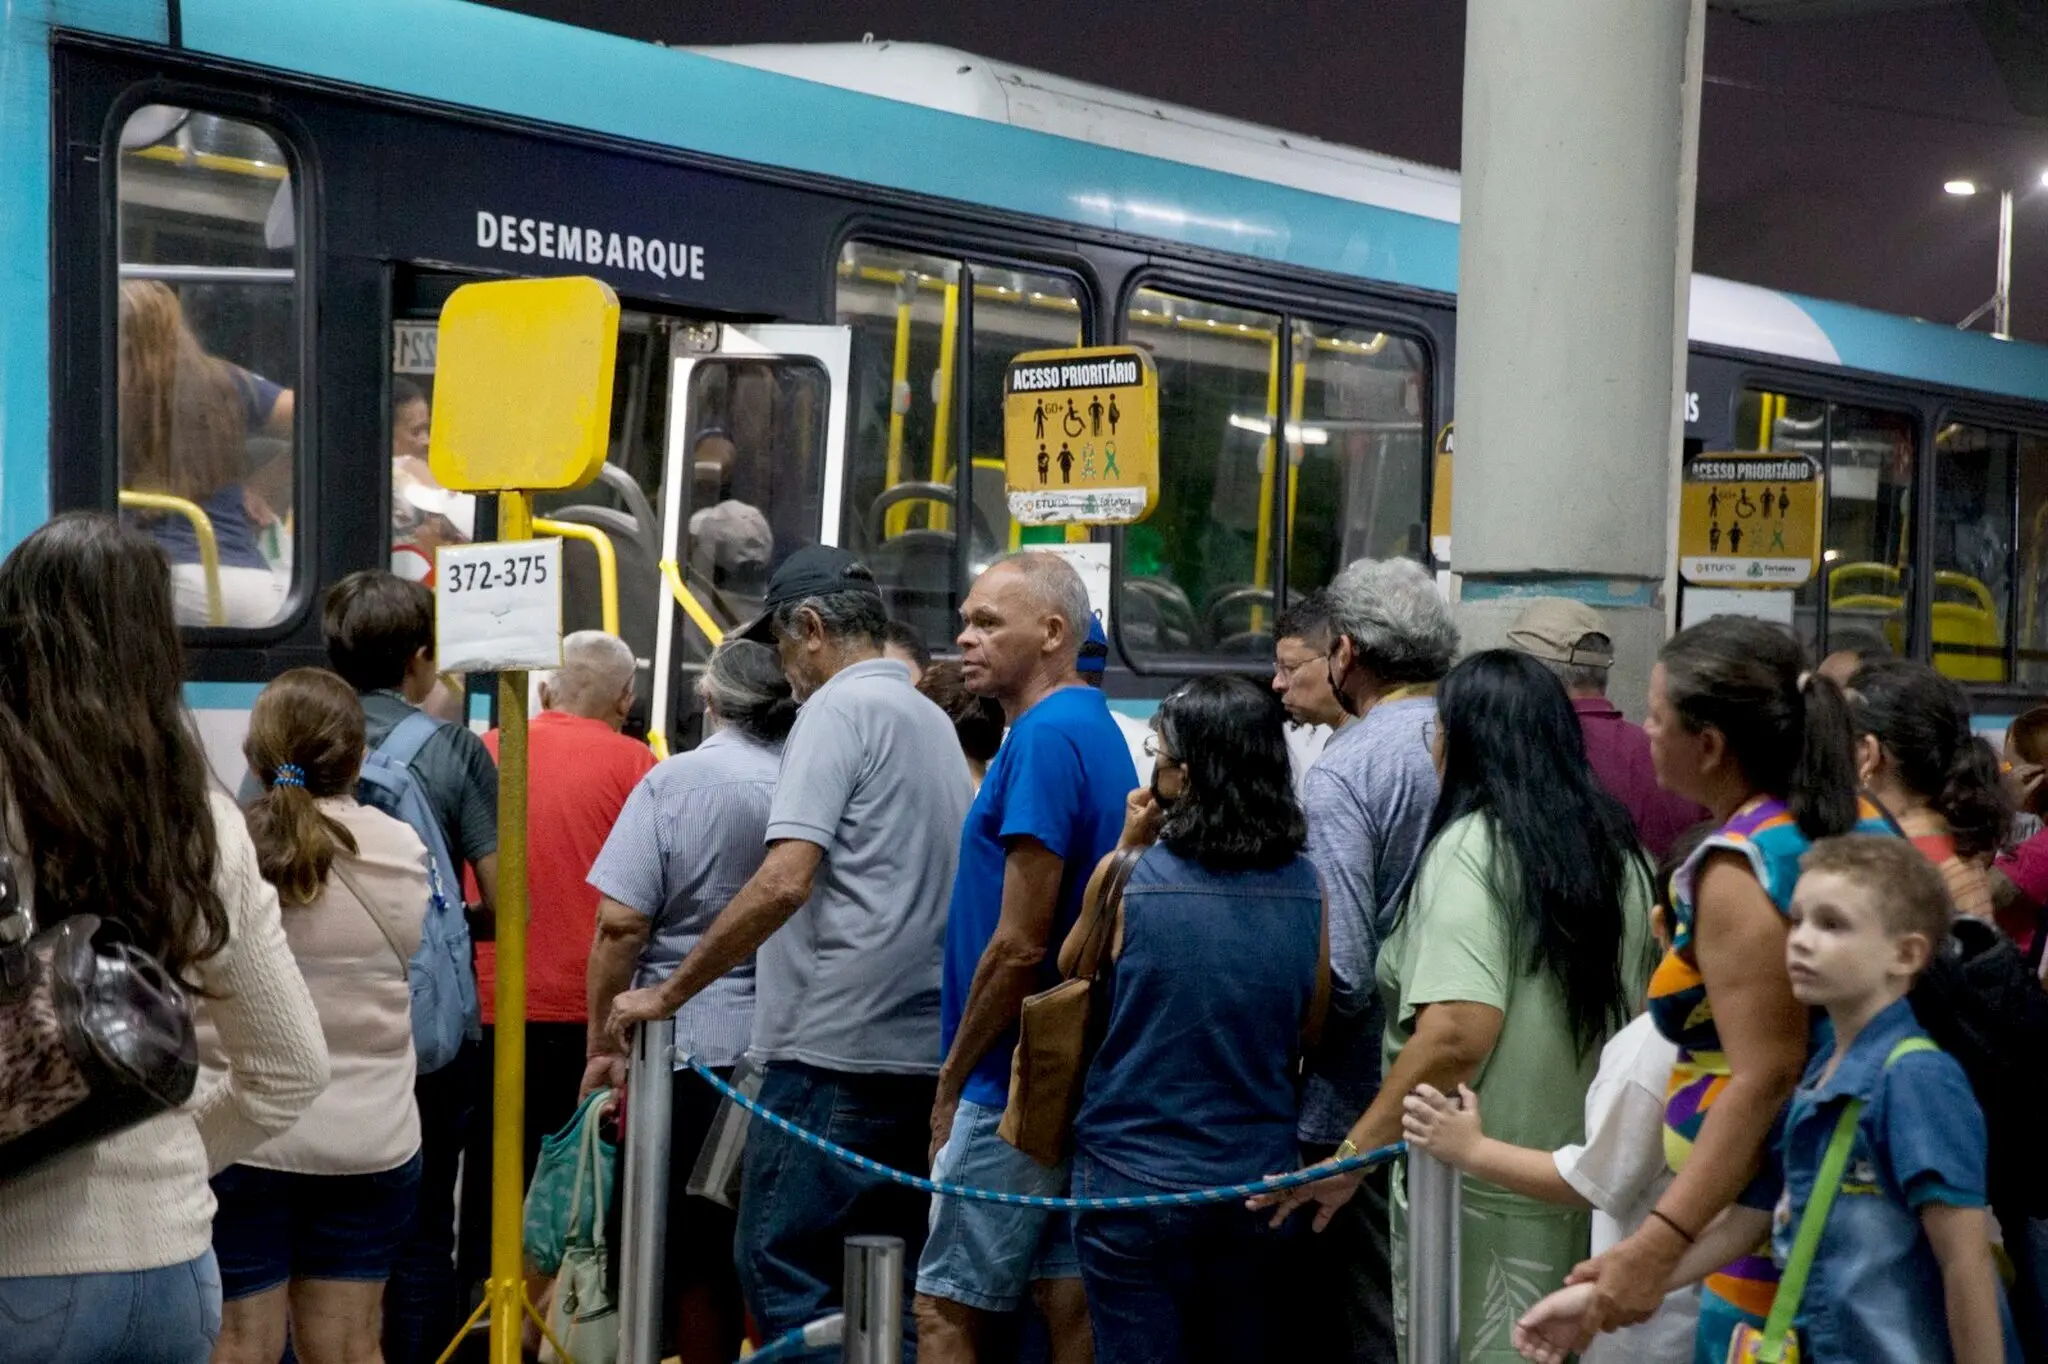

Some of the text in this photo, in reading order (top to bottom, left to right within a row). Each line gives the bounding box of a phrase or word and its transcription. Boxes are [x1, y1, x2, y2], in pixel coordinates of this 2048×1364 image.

[476, 210, 705, 281] DESEMBARQUE
[1013, 360, 1136, 390] ACESSO PRIORITÁRIO
[1692, 460, 1809, 480] ACESSO PRIORITÁRIO
[448, 555, 547, 593] 372-375
